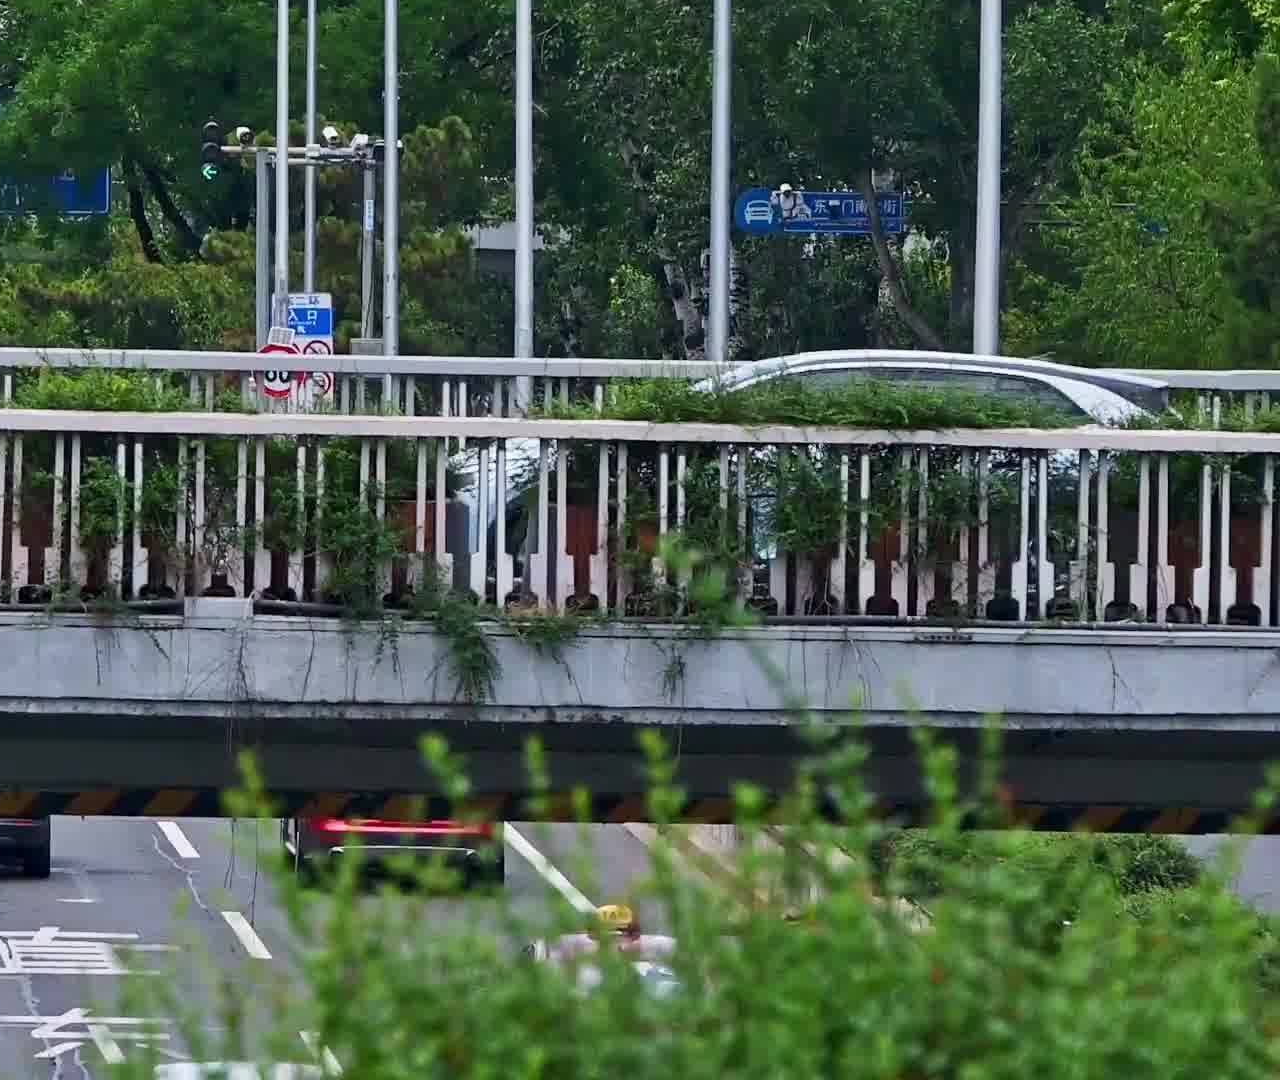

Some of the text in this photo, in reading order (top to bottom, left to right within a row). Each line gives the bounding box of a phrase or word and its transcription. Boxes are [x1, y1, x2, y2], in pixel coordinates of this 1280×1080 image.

[814, 199, 897, 216] 东门南街
[287, 309, 318, 321] 入口
